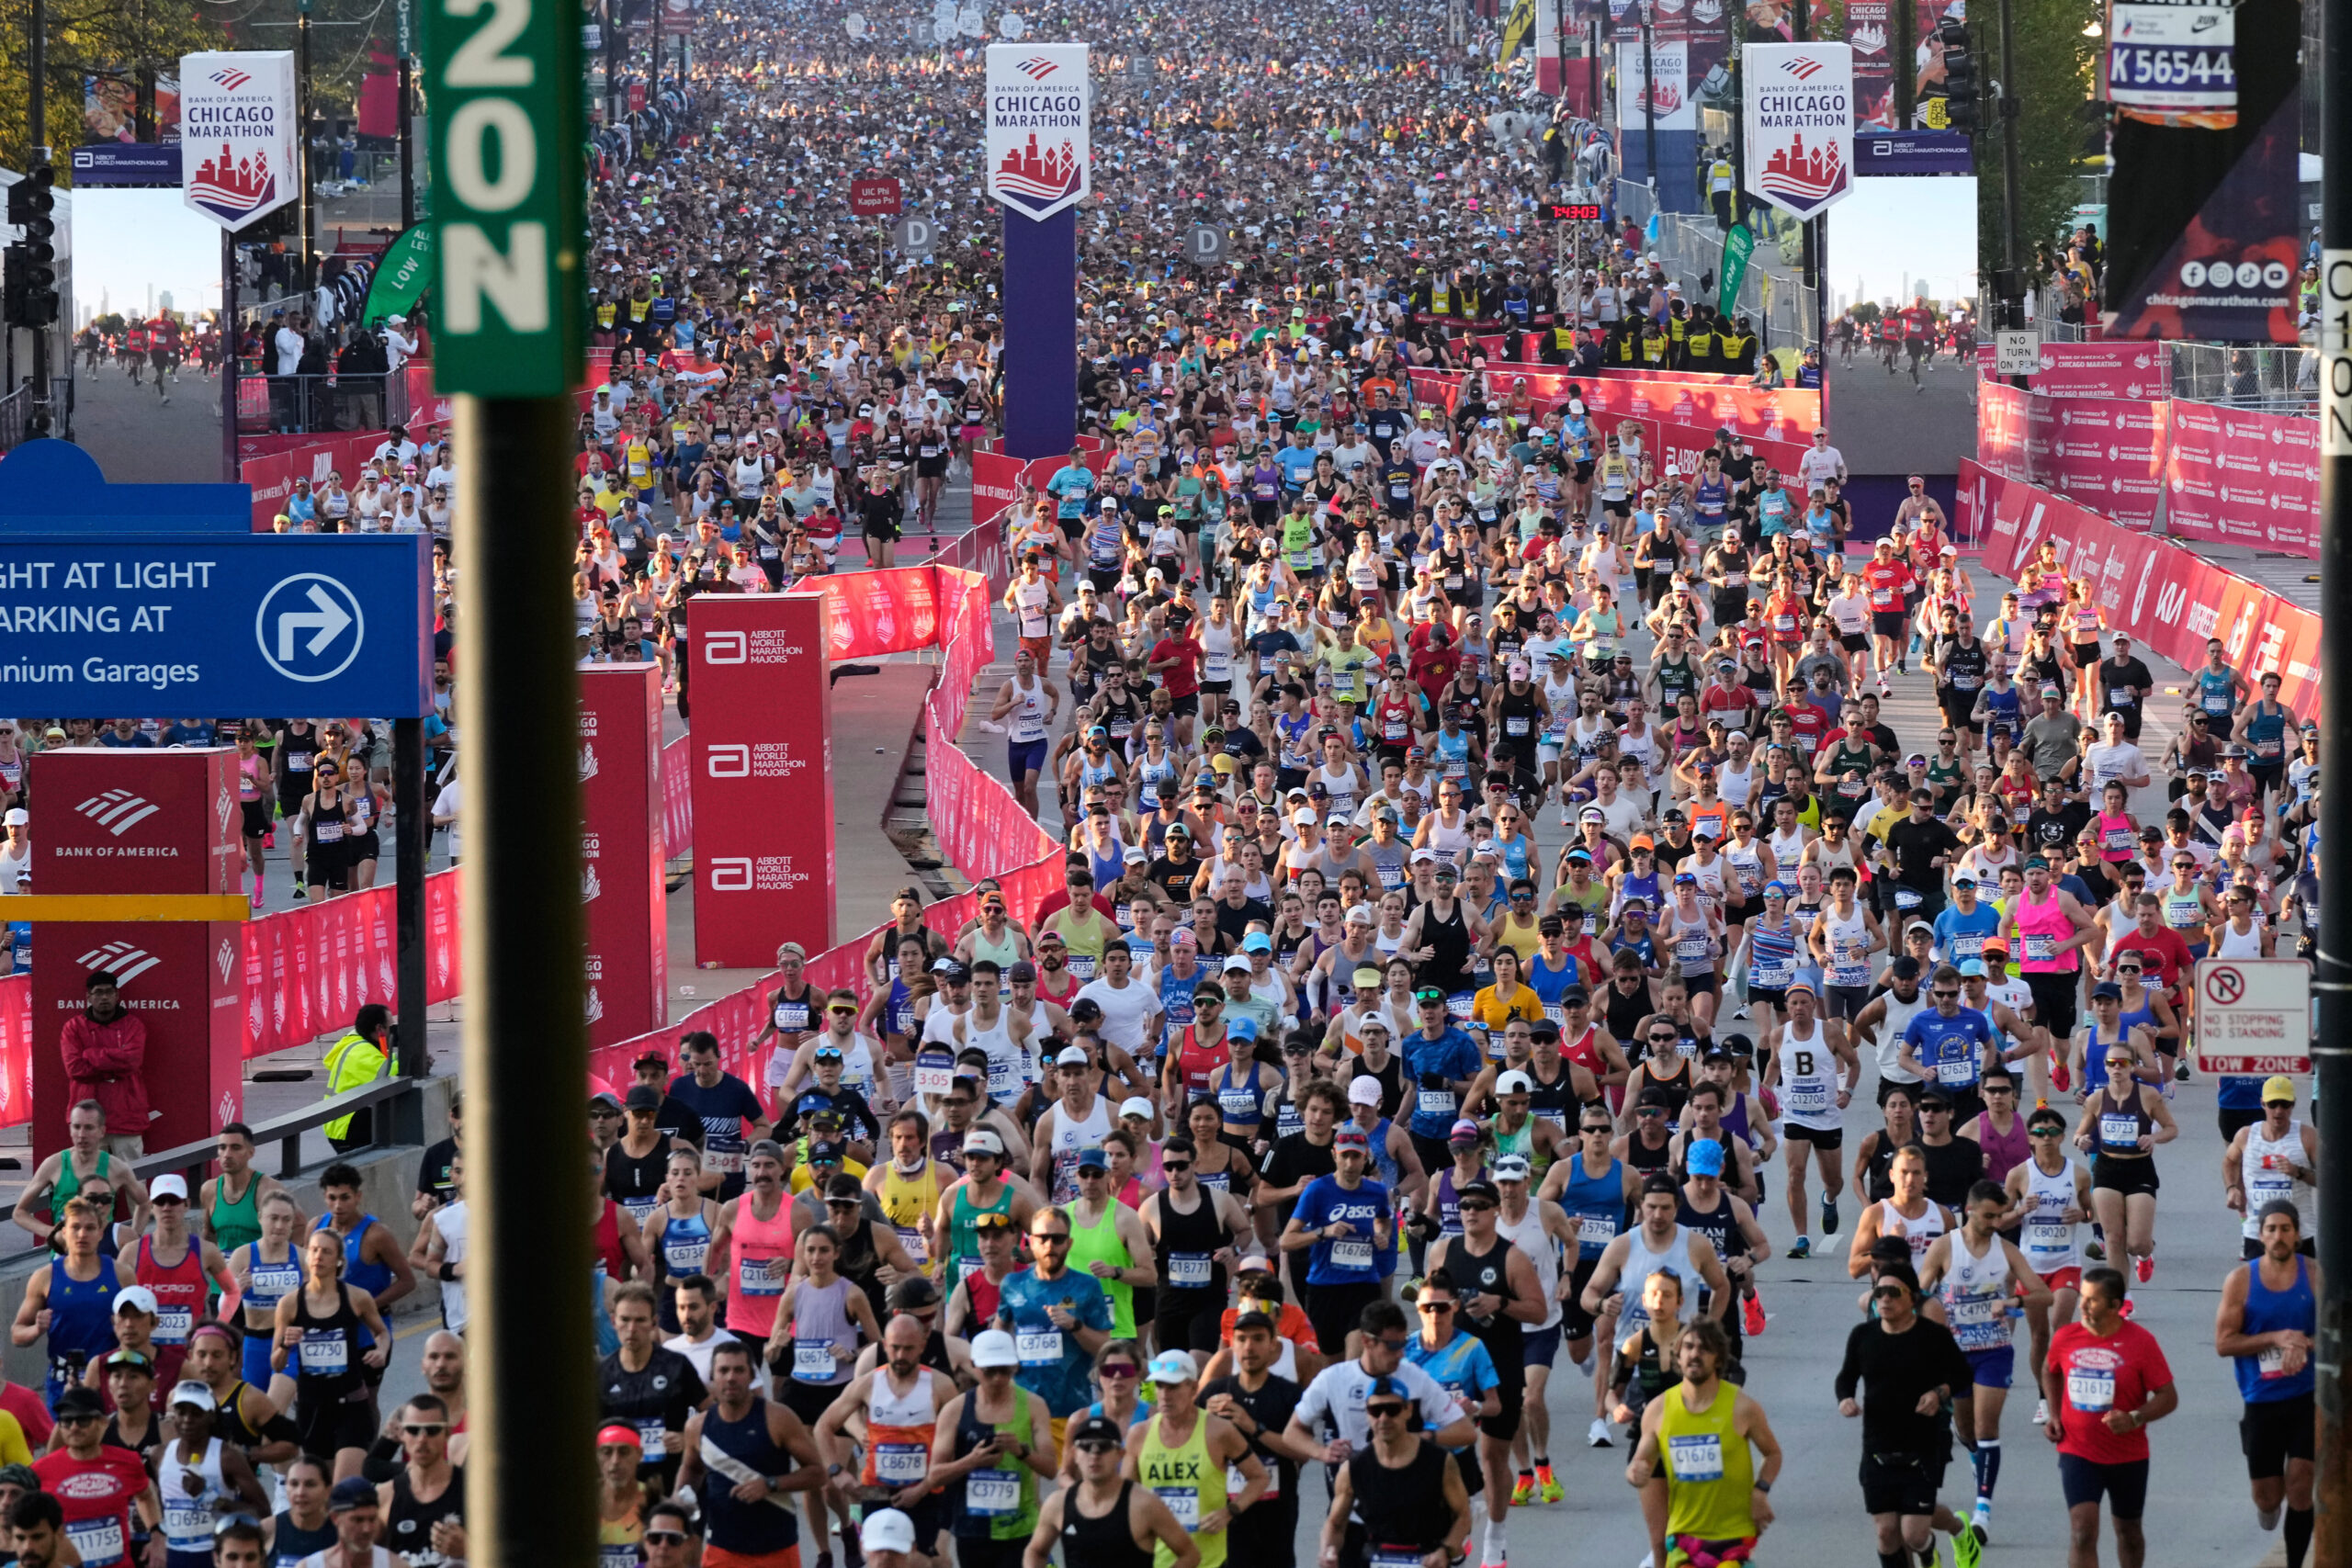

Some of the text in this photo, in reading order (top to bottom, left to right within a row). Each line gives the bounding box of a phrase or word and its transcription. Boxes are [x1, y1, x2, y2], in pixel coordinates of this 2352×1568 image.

[1635, 58, 1681, 67] CICAGO
[2109, 48, 2235, 85] K 56544
[1801, 85, 1844, 93] AMERICA
[188, 96, 213, 104] BANK
[995, 96, 1081, 112] CHICAGO
[1760, 96, 1845, 112] CHICAGO
[188, 107, 275, 123] CHICAGO
[995, 115, 1081, 127] MARATHON
[1760, 114, 1845, 128] MARATHON
[188, 125, 275, 138] MARATHON
[862, 186, 889, 196] UIC Phi
[858, 196, 895, 207] Kappa Psi
[908, 221, 928, 246] D
[1197, 230, 1218, 254] D
[391, 256, 419, 289] LOW
[2146, 294, 2290, 309] chicagomarathon.com
[2009, 336, 2026, 345] NO
[2006, 348, 2031, 357] TURN
[2000, 360, 2013, 369] ON
[312, 451, 333, 483] RUN
[973, 483, 987, 496] BANK
[994, 488, 1014, 501] AMERICA
[0, 561, 217, 589] HT AT LIGHT
[130, 605, 172, 633] AT
[750, 630, 786, 638] ABBOTT
[750, 647, 803, 656] MARATHON
[751, 655, 788, 663] MAJORS
[0, 656, 199, 691] nium Garages
[753, 743, 789, 751] ABBOTT
[753, 752, 788, 761] WORLD
[753, 761, 806, 769] MARATHON
[753, 768, 791, 777] MAJORS
[56, 847, 179, 857] BANK OF AMERICA
[756, 856, 792, 865] ABBOTT
[756, 865, 790, 874] WORLD
[756, 873, 808, 882] MARATHON
[756, 881, 793, 890] MAJORS
[1678, 942, 1706, 952] C16795
[1068, 964, 1091, 972] C4730
[1759, 970, 1788, 980] C15796
[119, 1000, 181, 1010] AMERICA
[2205, 1014, 2285, 1025] NO STOPPING
[2205, 1028, 2285, 1038] NO STANDING
[1794, 1052, 1814, 1076] B
[2206, 1056, 2301, 1072] TOW ZONE
[1940, 1065, 1970, 1076] C7626
[918, 1073, 948, 1087] 3:05
[989, 1075, 1006, 1086] 687
[1423, 1093, 1451, 1104] C3612
[1792, 1094, 1825, 1104] C12708
[2105, 1122, 2134, 1134] C8723
[707, 1156, 739, 1168] 3:05
[1582, 1220, 1613, 1234] 15794
[2034, 1226, 2067, 1238] C8020
[1170, 1260, 1209, 1274] C18771
[254, 1272, 298, 1287] C21789
[741, 1268, 772, 1280] C216
[304, 1343, 342, 1358] C2730
[2069, 1380, 2111, 1395] C21612
[1675, 1447, 1715, 1462] C1676
[881, 1454, 922, 1470] C8678
[1148, 1462, 1201, 1481] ALEX
[972, 1483, 1013, 1497] C3779
[71, 1528, 122, 1551] 11755
